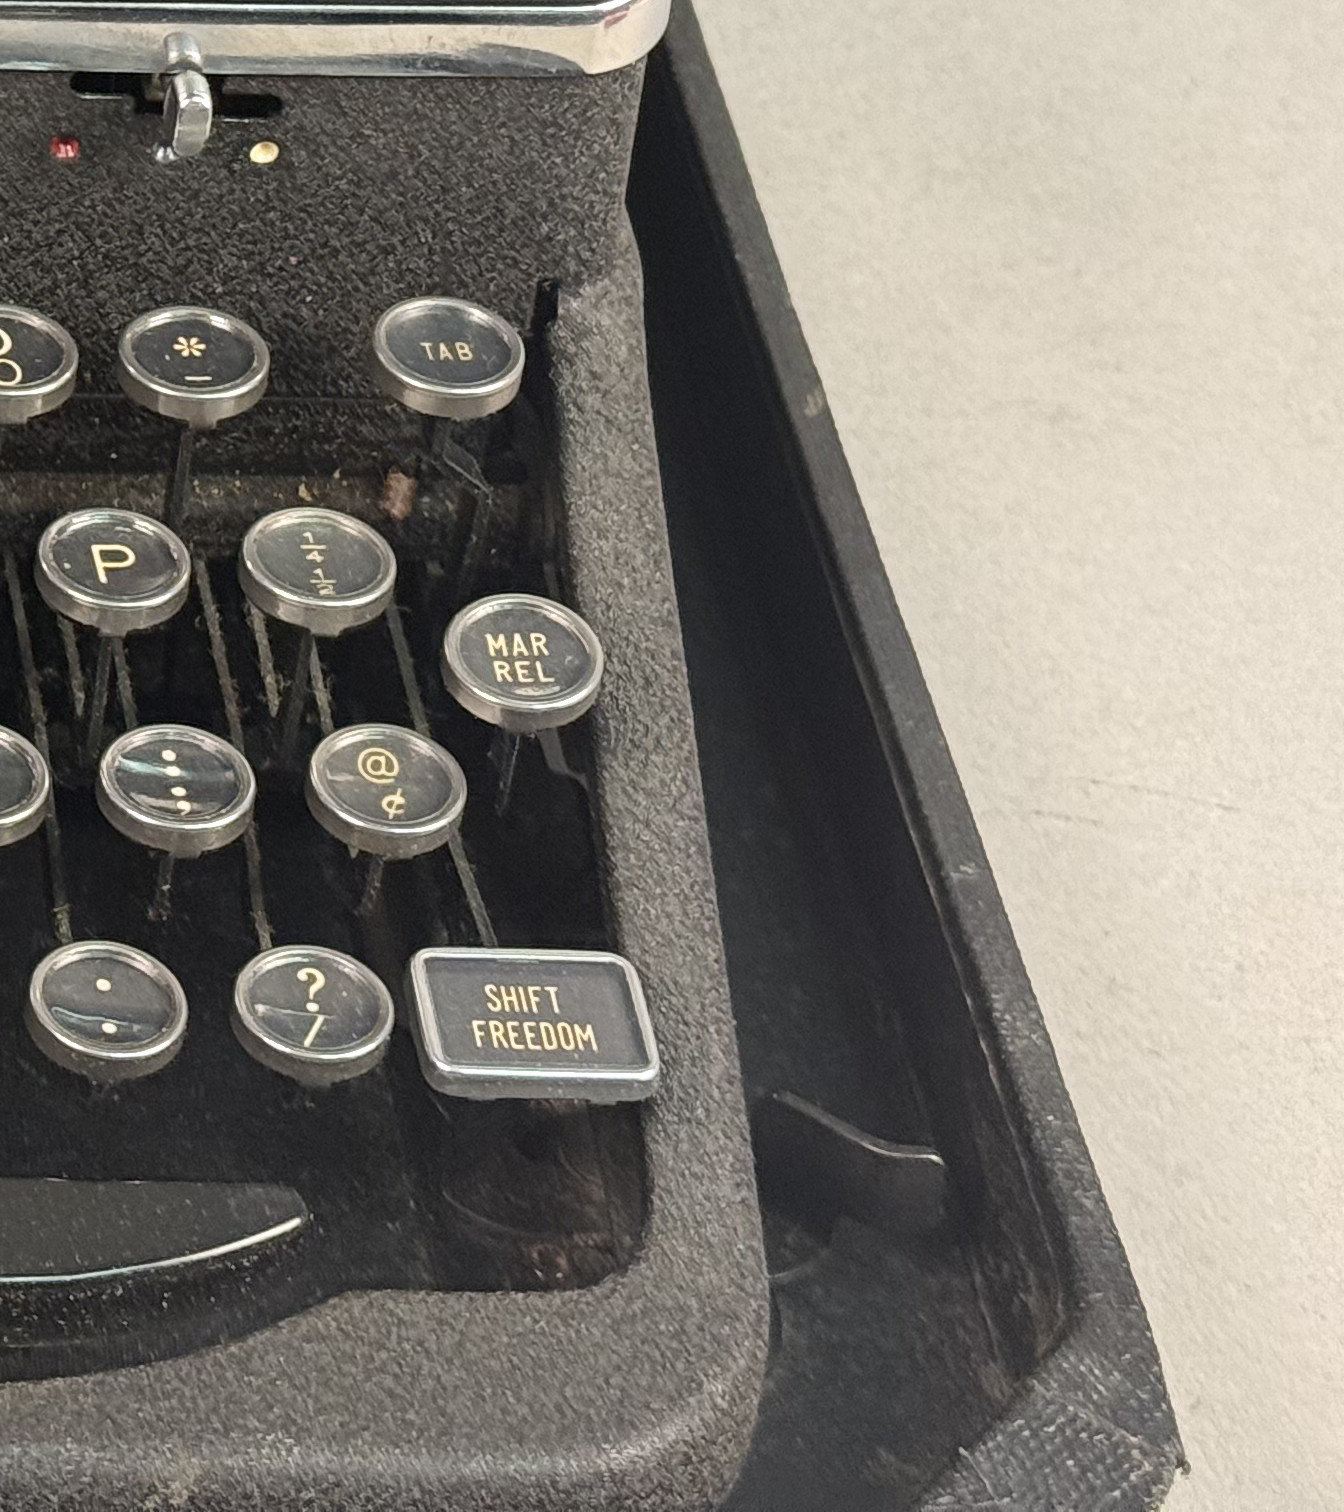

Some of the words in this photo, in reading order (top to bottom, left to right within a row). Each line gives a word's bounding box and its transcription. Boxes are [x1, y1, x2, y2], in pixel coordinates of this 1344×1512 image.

[419, 341, 473, 361] TAB
[90, 544, 136, 584] P
[484, 632, 550, 657] MAR
[492, 659, 556, 685] REL
[357, 747, 400, 784] @
[296, 967, 326, 1013] ?
[484, 984, 560, 1014] SHIFT
[471, 1019, 598, 1052] FREEDOM
